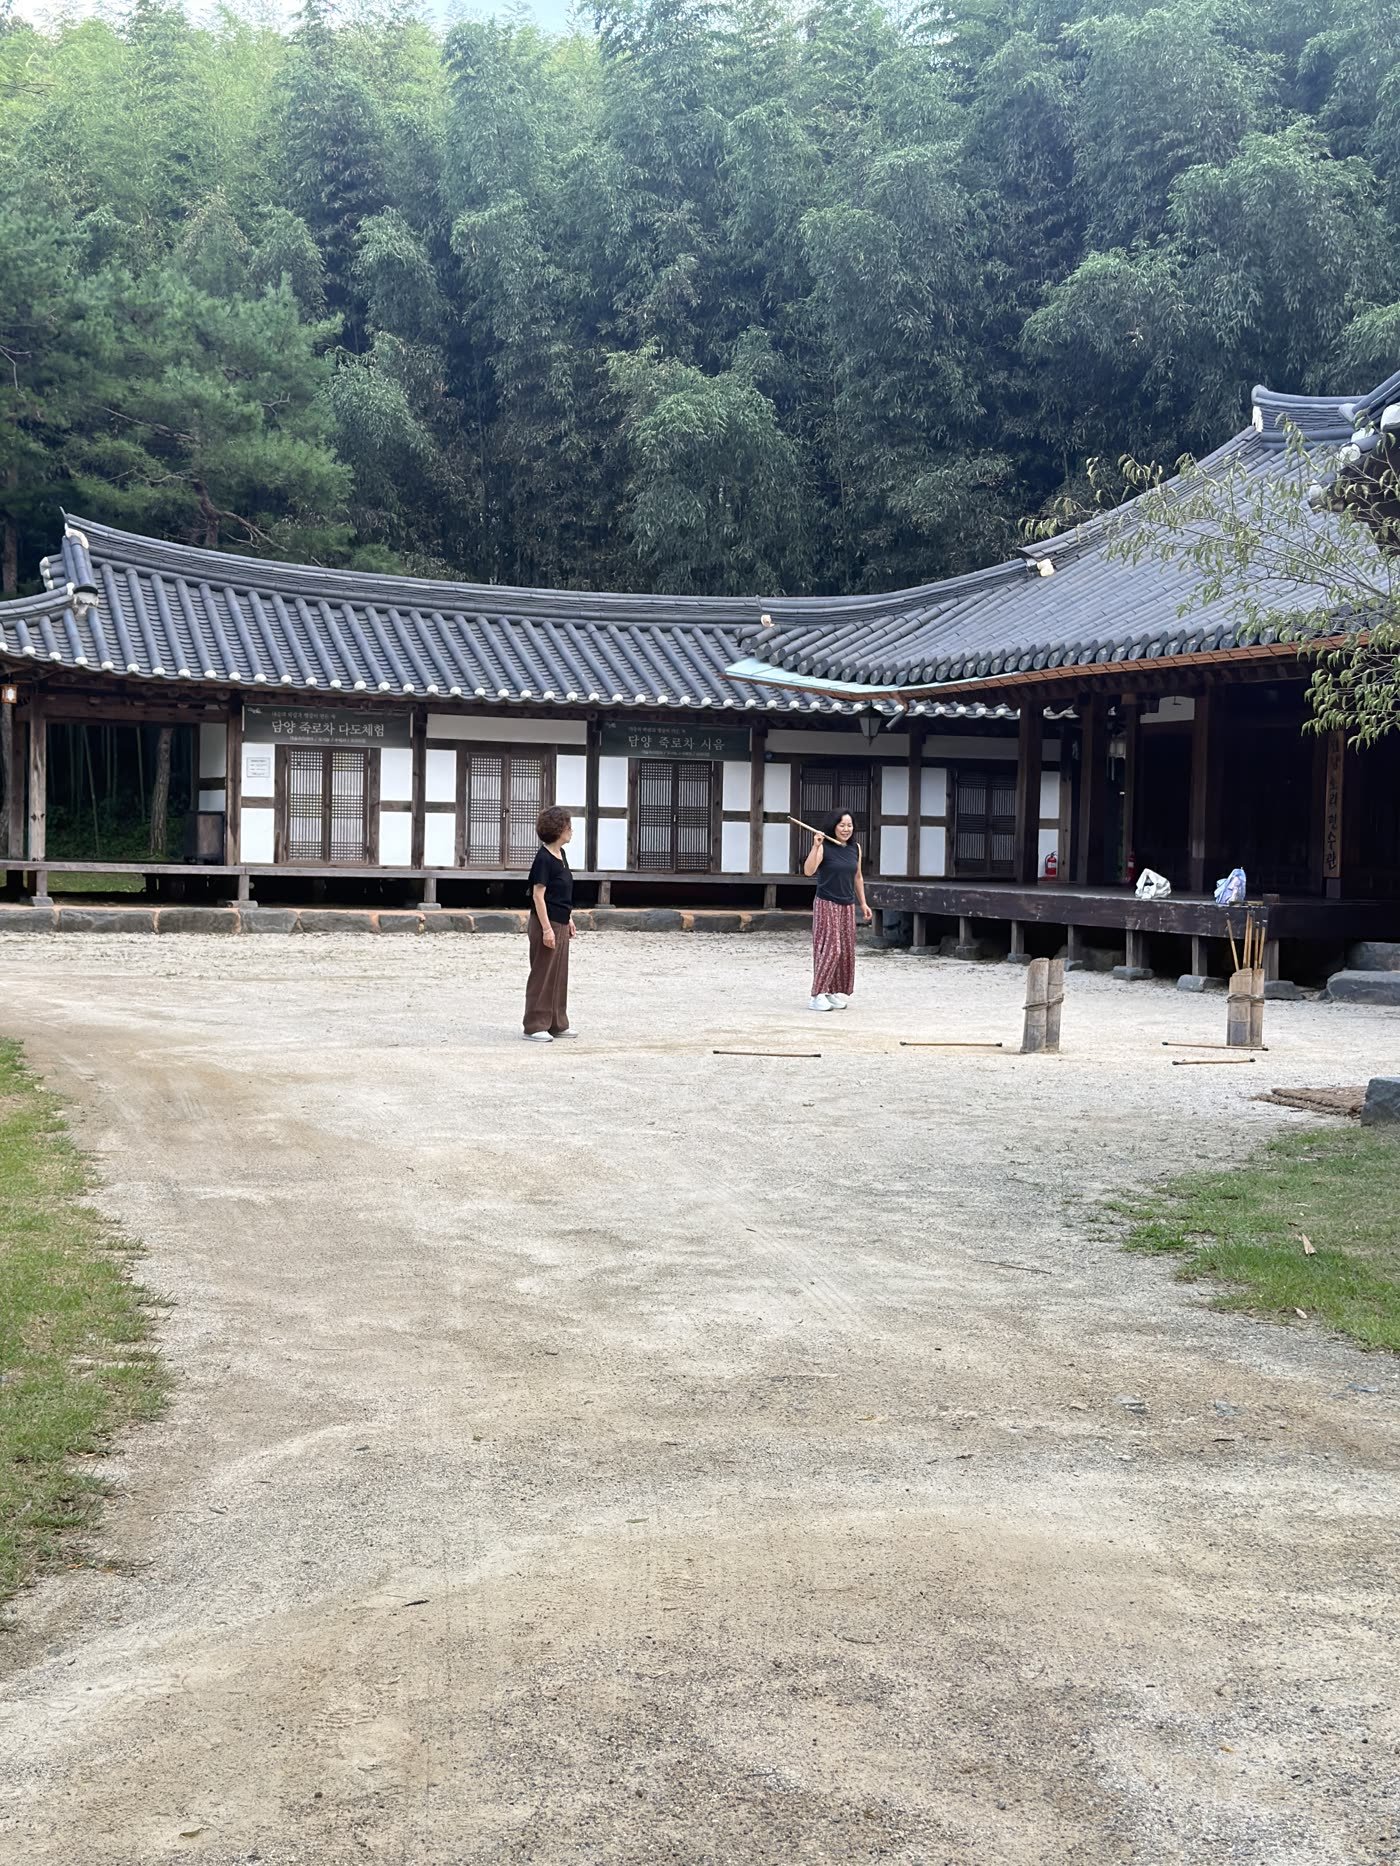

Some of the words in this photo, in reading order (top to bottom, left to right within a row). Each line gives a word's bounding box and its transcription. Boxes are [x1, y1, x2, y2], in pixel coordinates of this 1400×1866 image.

[272, 720, 296, 734] 담양
[299, 721, 335, 736] 죽로차
[339, 722, 385, 738] 다도체험
[628, 734, 652, 749] 담양
[659, 736, 695, 750] 죽로차
[701, 737, 725, 751] 시음
